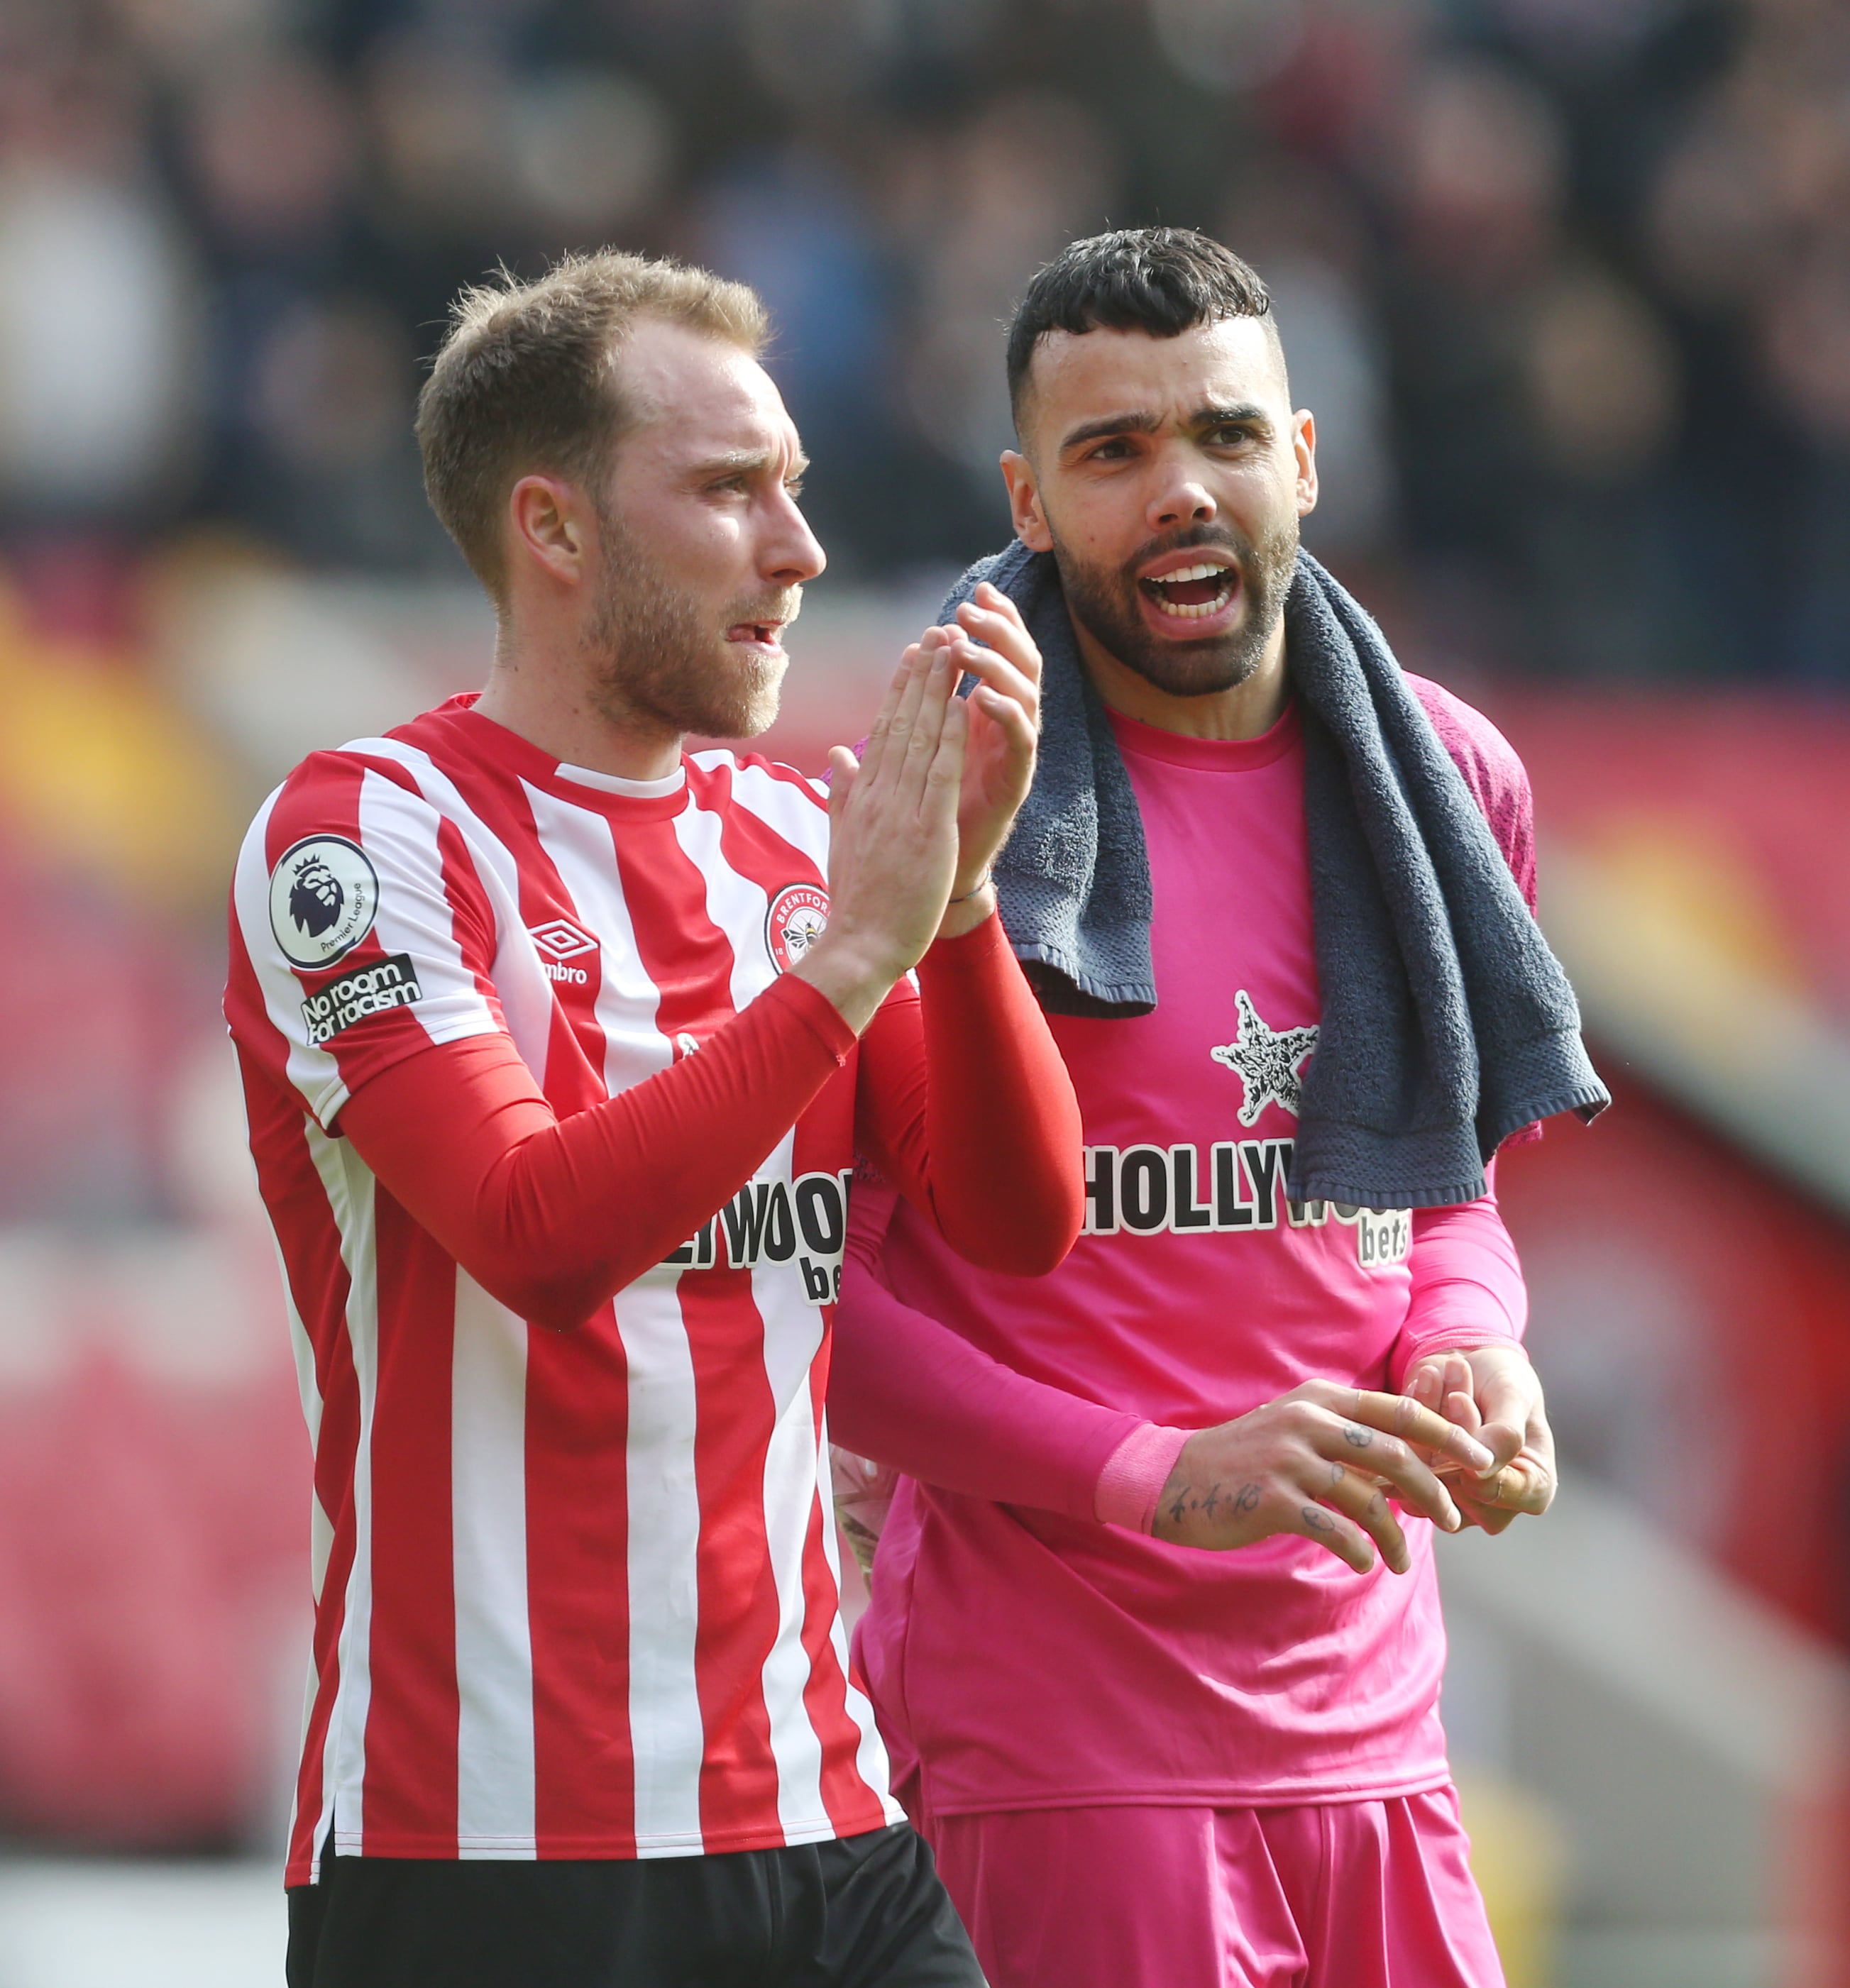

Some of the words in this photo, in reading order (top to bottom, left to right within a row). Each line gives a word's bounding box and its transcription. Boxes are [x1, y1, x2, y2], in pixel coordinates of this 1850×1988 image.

[320, 923, 354, 953] Premier
[348, 883, 365, 922] League
[776, 893, 831, 924] BRENTFOR
[302, 995, 331, 1028] No
[329, 963, 402, 1008] room
[336, 981, 422, 1029] racism
[1361, 1215, 1408, 1261] bets
